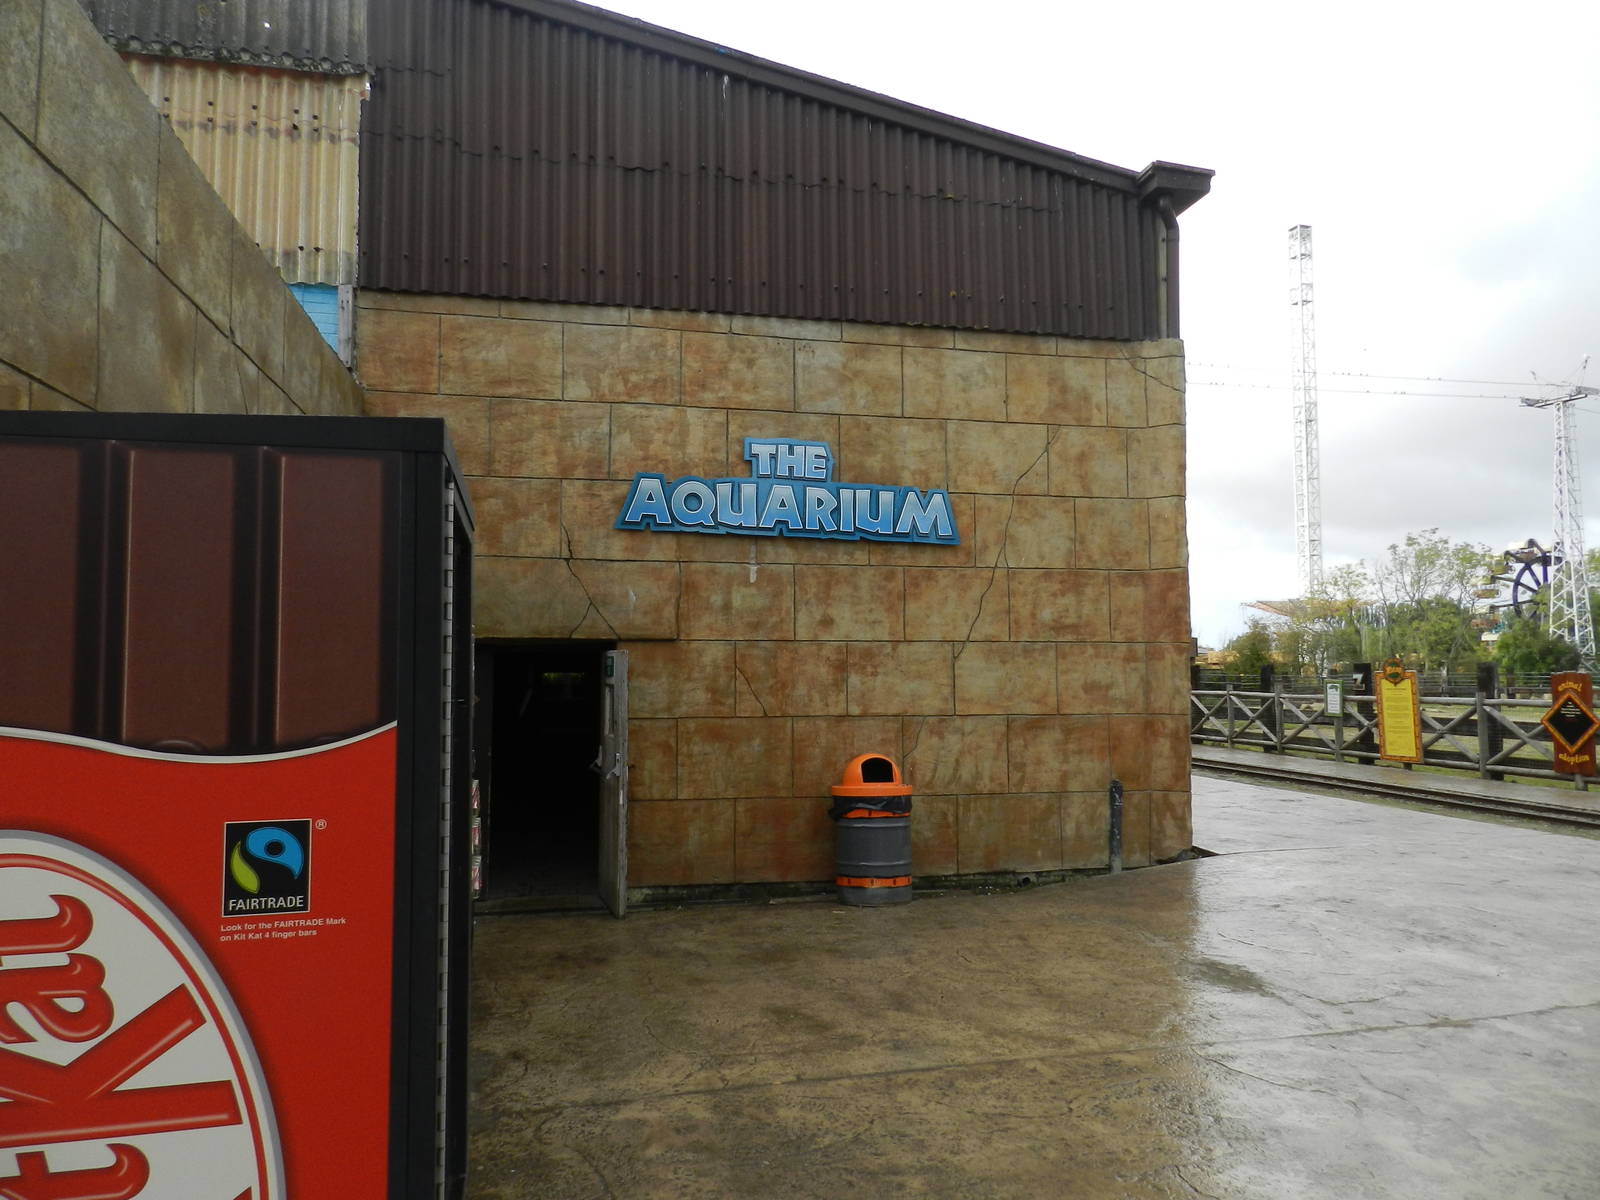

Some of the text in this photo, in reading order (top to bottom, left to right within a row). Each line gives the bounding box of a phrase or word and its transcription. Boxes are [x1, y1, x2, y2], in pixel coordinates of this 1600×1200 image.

[750, 443, 829, 480] THE
[624, 477, 953, 536] AQUARIUM
[228, 895, 305, 911] FAIRTRADE
[220, 924, 242, 932] Look
[258, 922, 272, 930] the
[274, 918, 324, 928] FAIRTRADE
[326, 917, 346, 926] Mark
[233, 933, 246, 941] Kit
[248, 932, 262, 940] Kat
[271, 930, 296, 940] finger
[298, 928, 318, 937] bars
